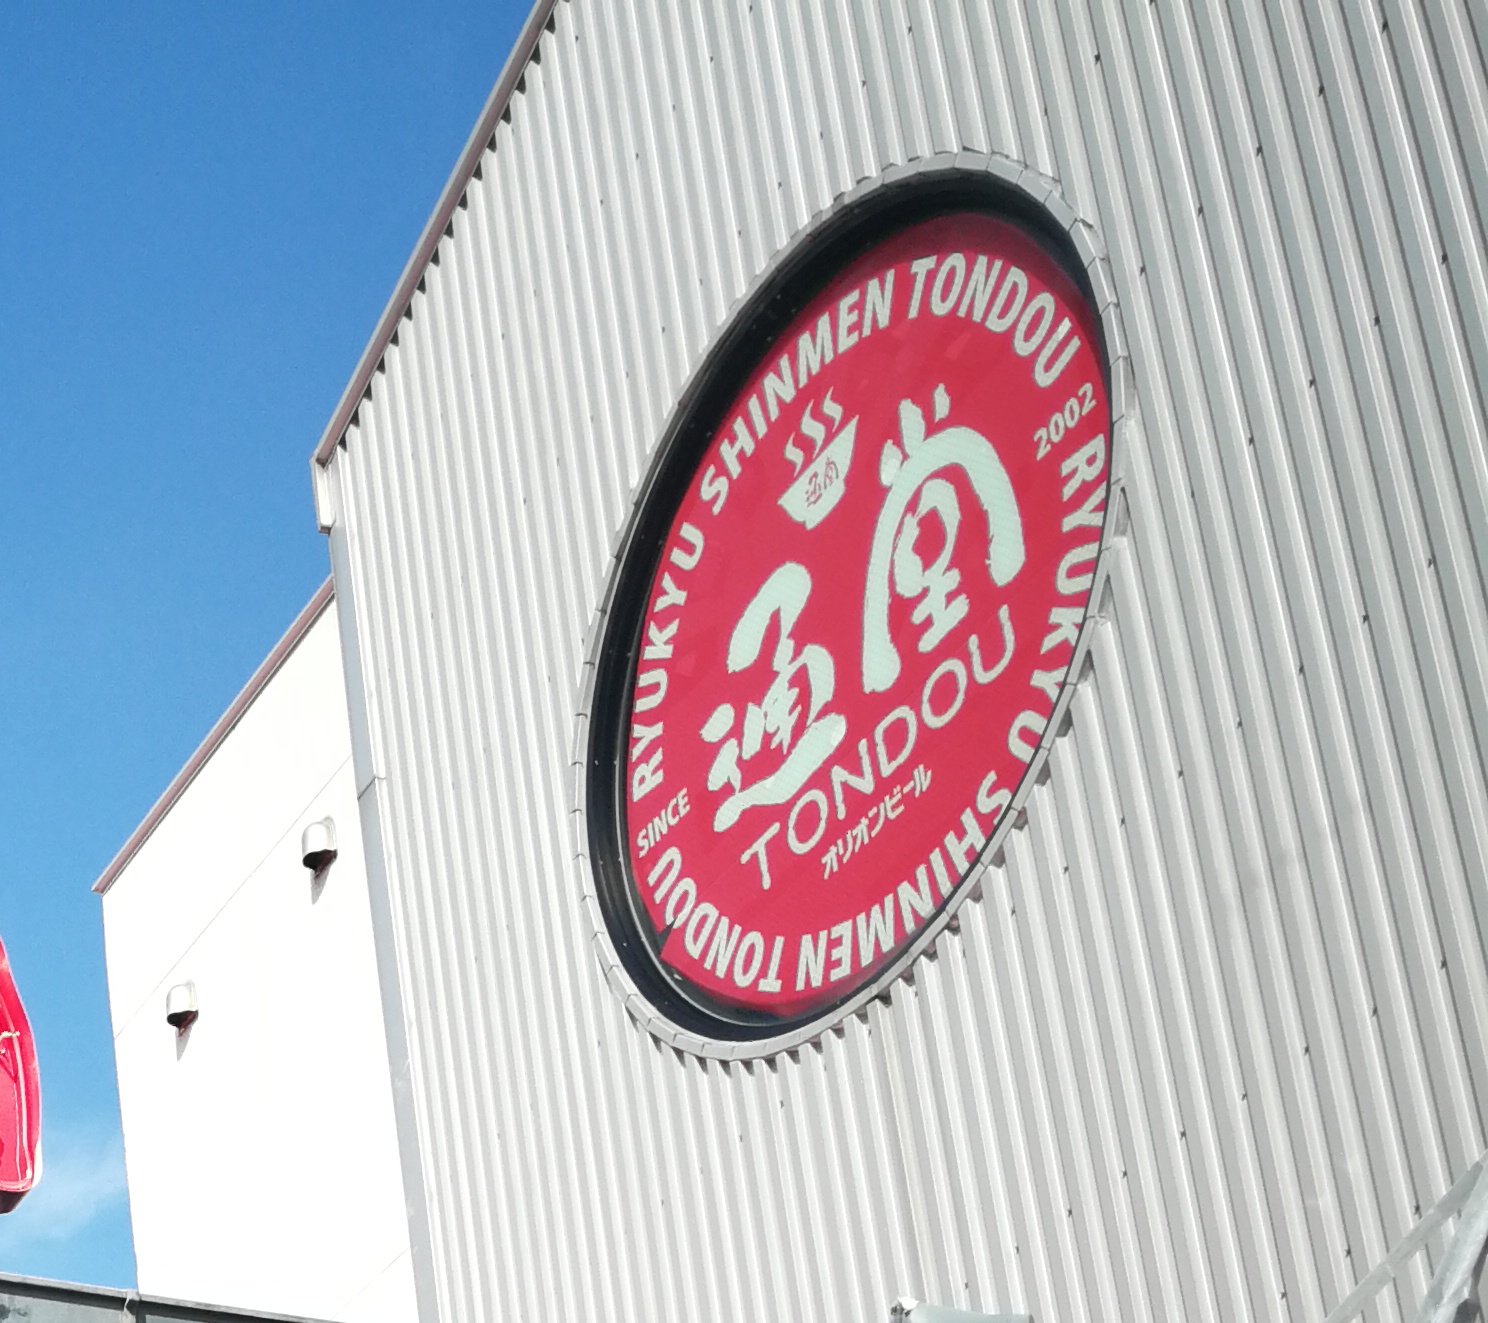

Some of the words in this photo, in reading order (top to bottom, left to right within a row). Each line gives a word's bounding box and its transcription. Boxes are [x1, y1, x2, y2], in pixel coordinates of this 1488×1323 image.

[1033, 382, 1098, 462] 2002
[632, 517, 708, 802] RYUKYU
[699, 269, 896, 511] SHINMEN
[908, 252, 1082, 388] TONDOU
[1006, 430, 1108, 766] RYUKYU
[636, 790, 691, 859] SINCE
[742, 603, 1018, 891] TONDOU
[820, 763, 933, 881] オリオンビール
[646, 845, 786, 994] TONDOU
[795, 777, 1015, 993] SHINMEN
